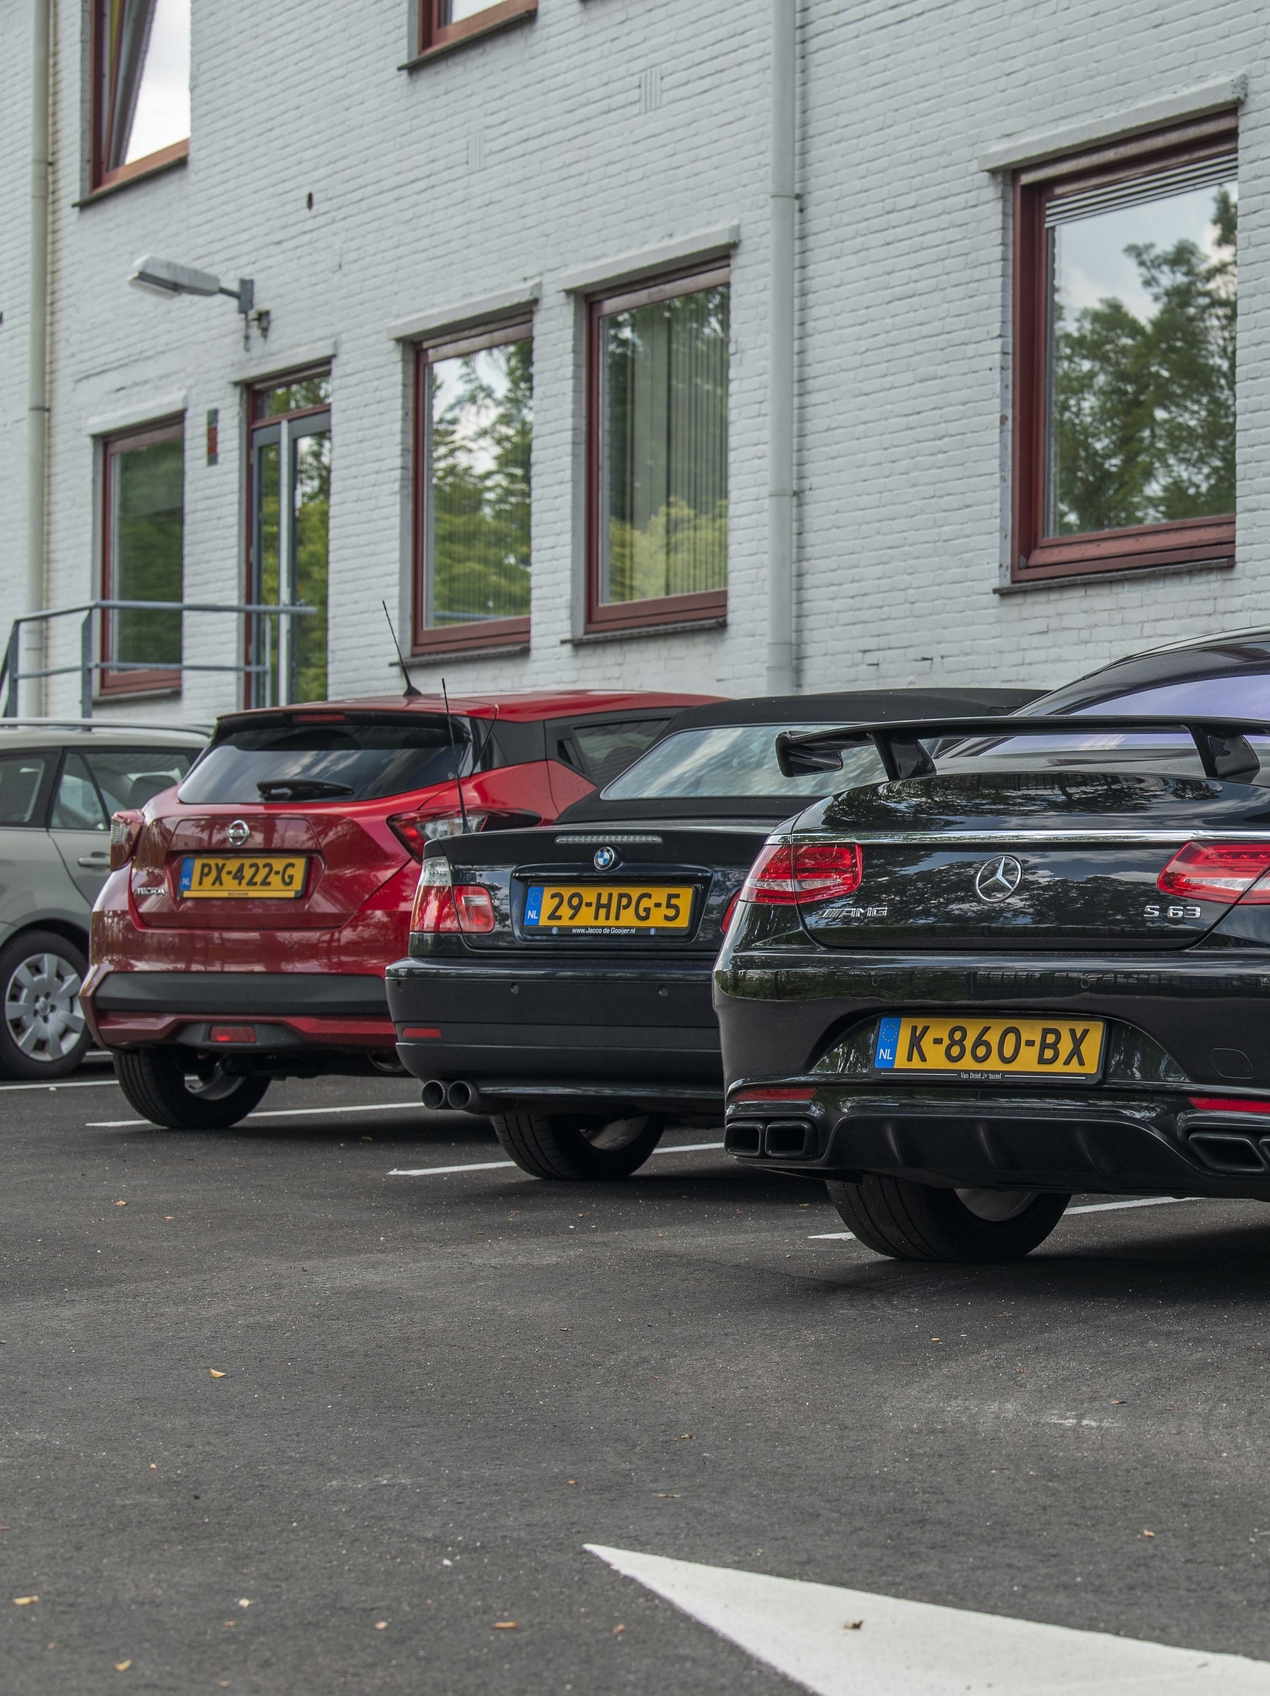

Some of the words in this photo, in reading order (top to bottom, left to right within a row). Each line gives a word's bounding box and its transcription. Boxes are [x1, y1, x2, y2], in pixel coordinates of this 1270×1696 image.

[182, 877, 191, 886] NL
[198, 862, 295, 887] PX-422-G
[547, 892, 681, 921] 29-HPG-5
[1143, 905, 1160, 917] S
[1167, 906, 1201, 919] 63
[527, 910, 538, 920] NL
[906, 1024, 1090, 1066] K-860-BX
[878, 1048, 893, 1060] NL
